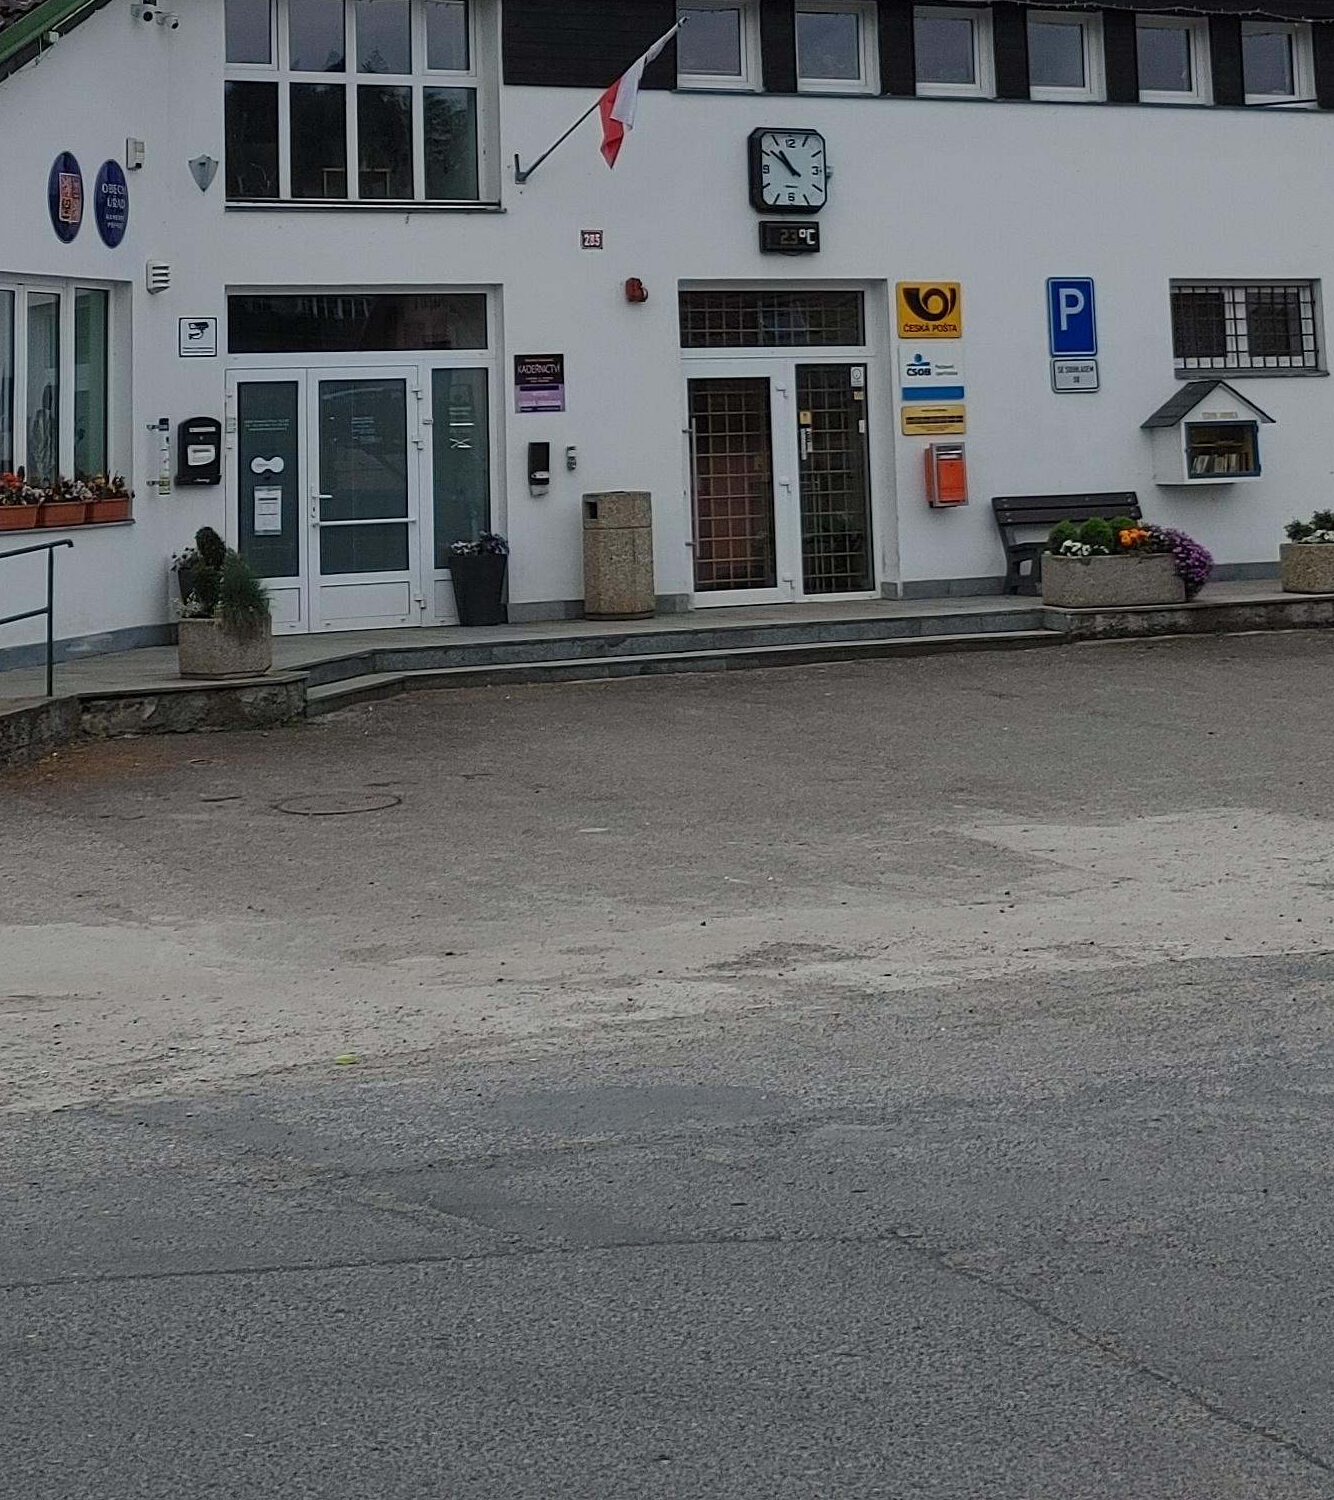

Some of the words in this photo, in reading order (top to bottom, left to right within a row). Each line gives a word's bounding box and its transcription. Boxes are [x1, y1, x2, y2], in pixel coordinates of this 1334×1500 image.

[786, 139, 796, 149] 12
[762, 164, 770, 174] 9
[811, 166, 819, 175] 3
[788, 192, 795, 202] 6
[1058, 287, 1085, 331] P
[903, 323, 930, 332] ČESKÁ
[932, 323, 957, 332] POŠTA
